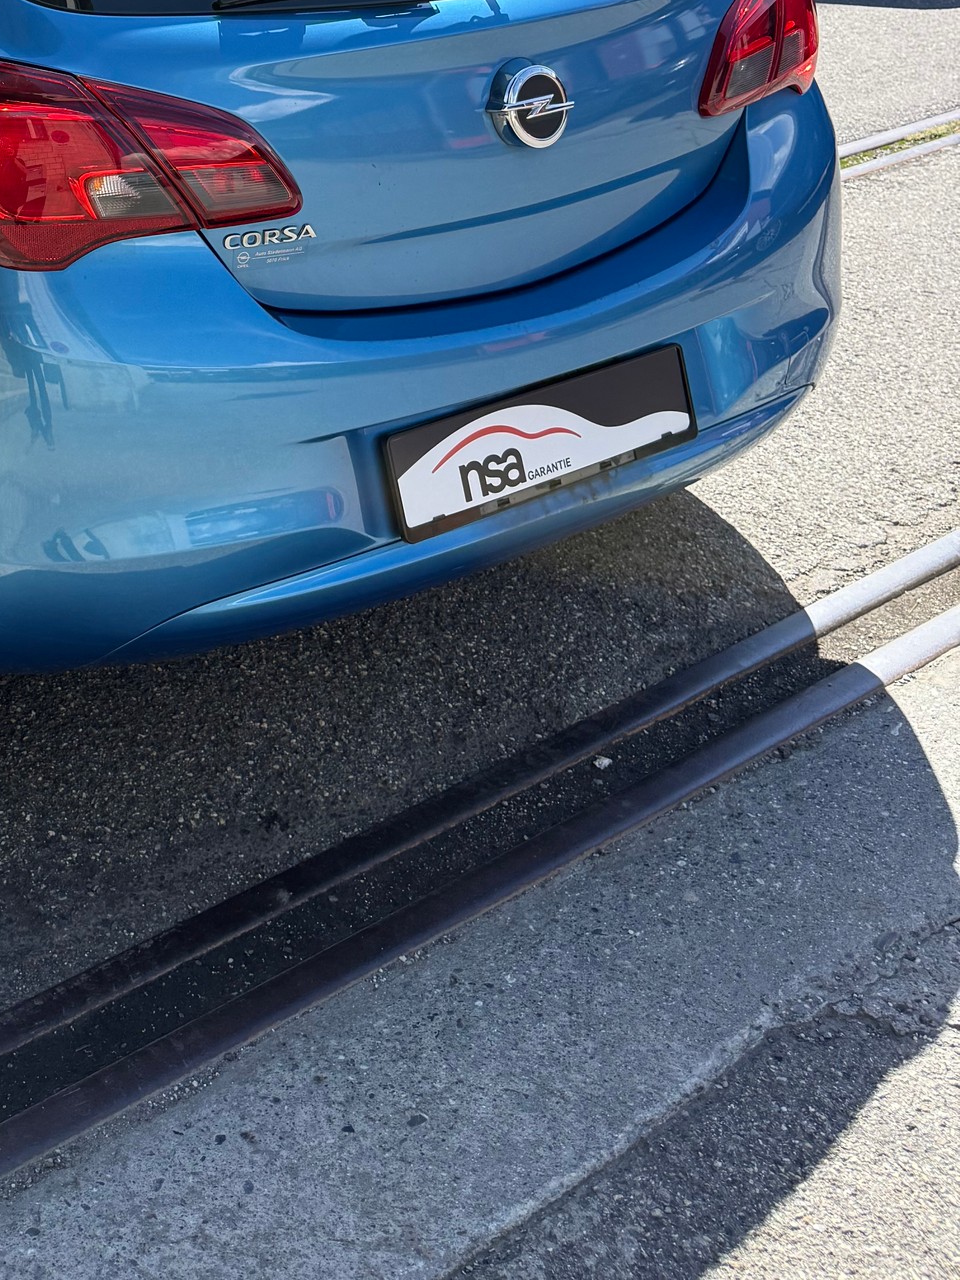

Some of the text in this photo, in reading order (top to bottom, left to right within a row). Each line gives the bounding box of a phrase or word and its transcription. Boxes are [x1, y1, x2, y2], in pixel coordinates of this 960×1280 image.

[223, 223, 317, 250] CORSA
[458, 447, 572, 503] nsa GARANTIE
